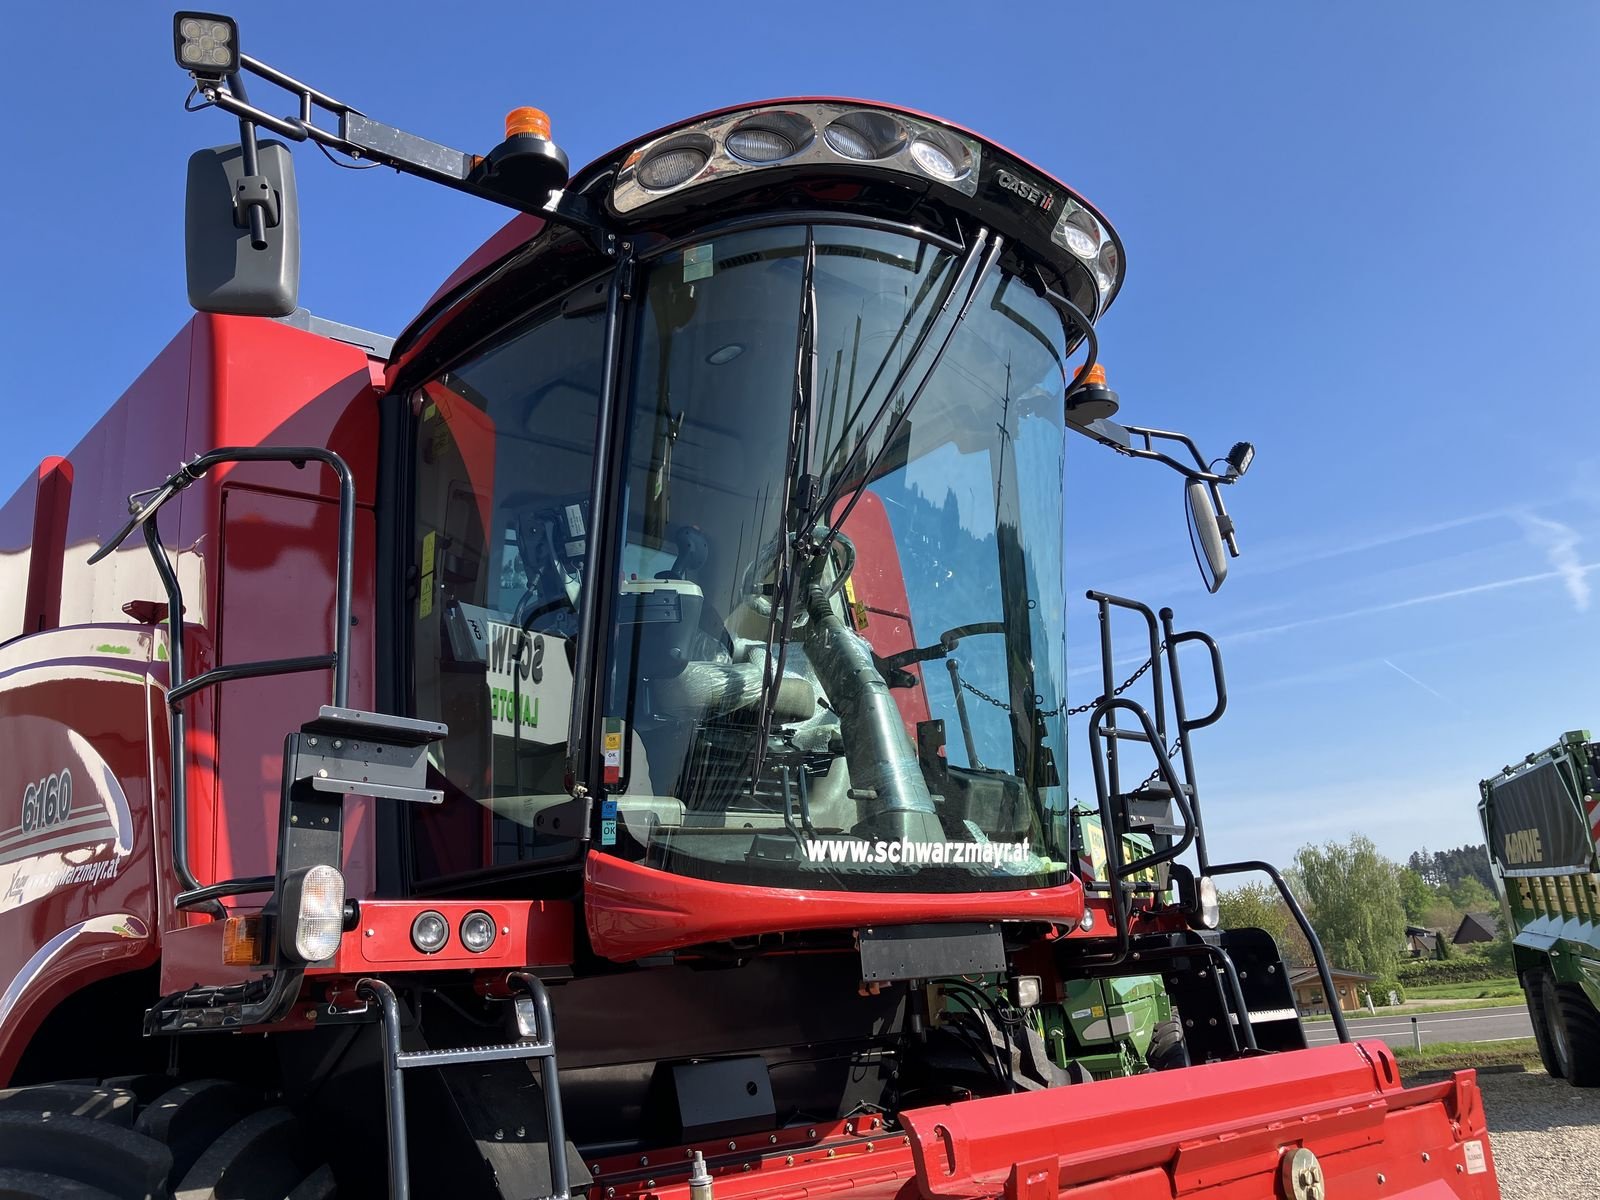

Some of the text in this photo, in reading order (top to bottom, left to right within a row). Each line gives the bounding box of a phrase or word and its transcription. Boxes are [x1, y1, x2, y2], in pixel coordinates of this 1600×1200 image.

[997, 169, 1041, 205] CASE
[22, 767, 73, 835] 6160
[603, 827, 616, 835] OK
[806, 836, 1030, 867] www.schwarzmayr.at
